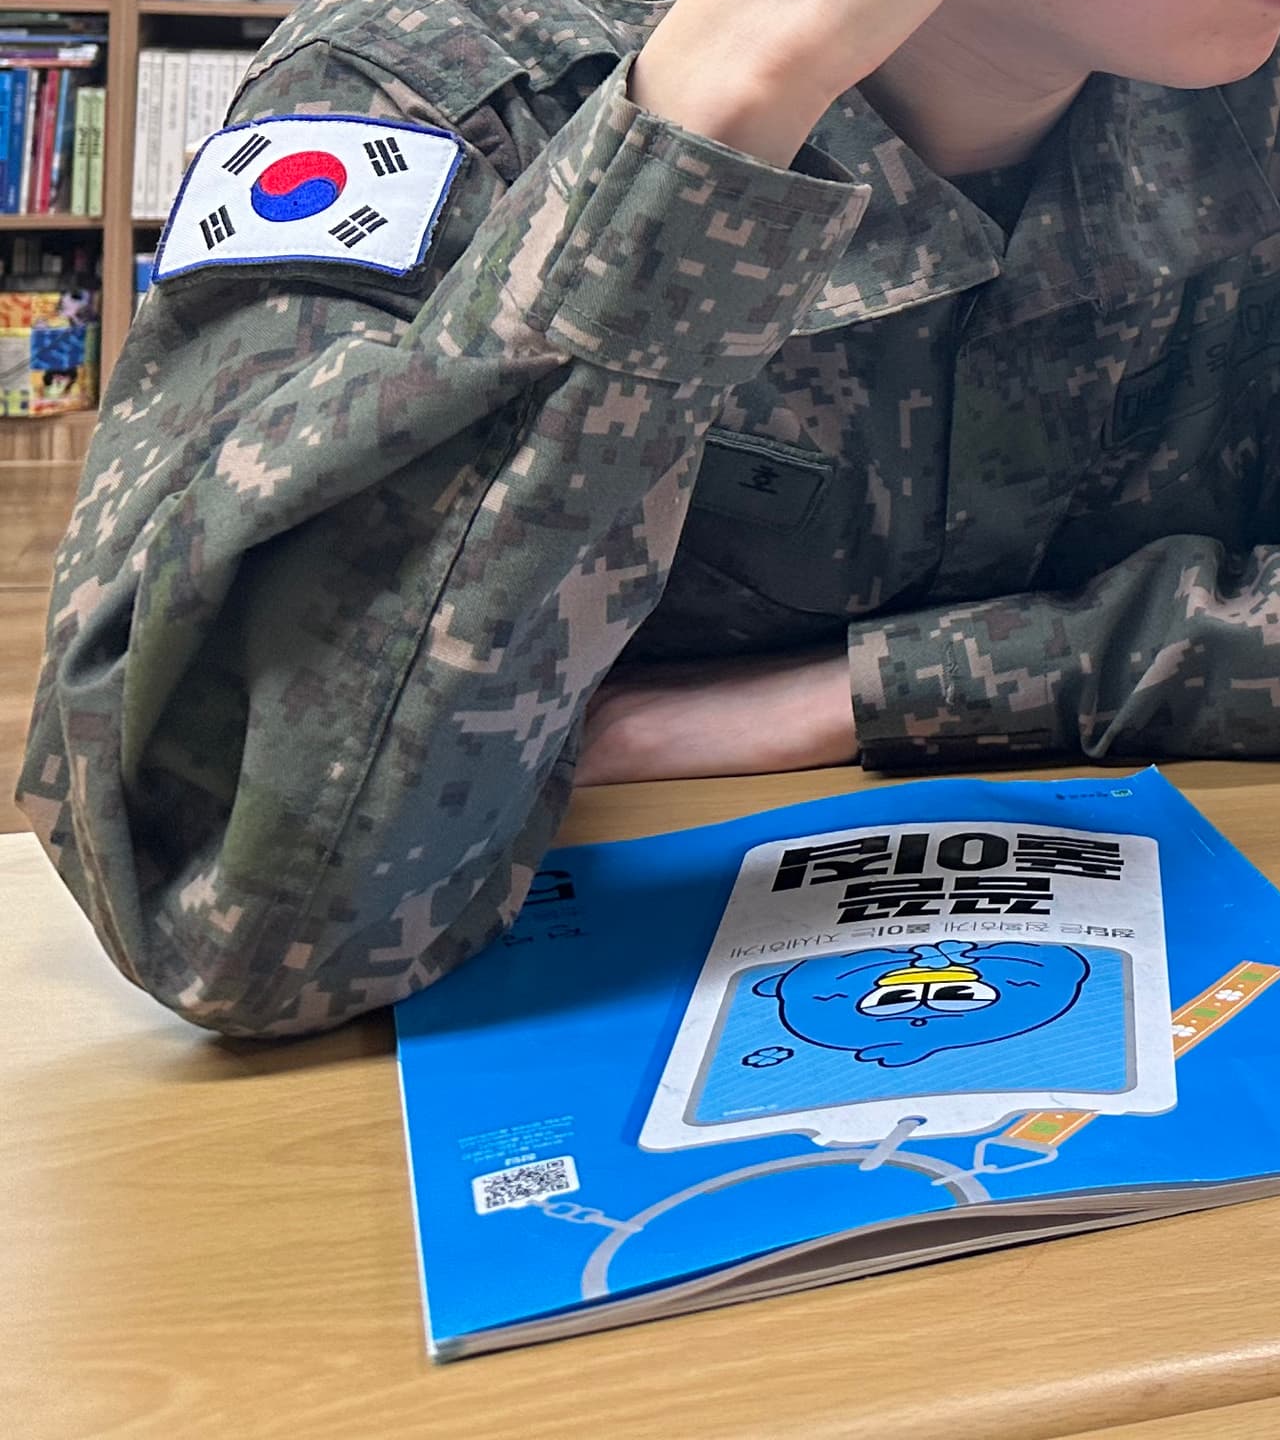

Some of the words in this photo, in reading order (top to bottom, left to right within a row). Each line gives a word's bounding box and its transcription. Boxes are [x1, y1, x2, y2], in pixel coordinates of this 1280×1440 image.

[772, 831, 1125, 892] 풀이집
[837, 874, 1054, 925] 꼼꼼
[851, 923, 931, 942] 풀이는
[1059, 921, 1137, 941] 정답은
[731, 932, 840, 959] 자세하게
